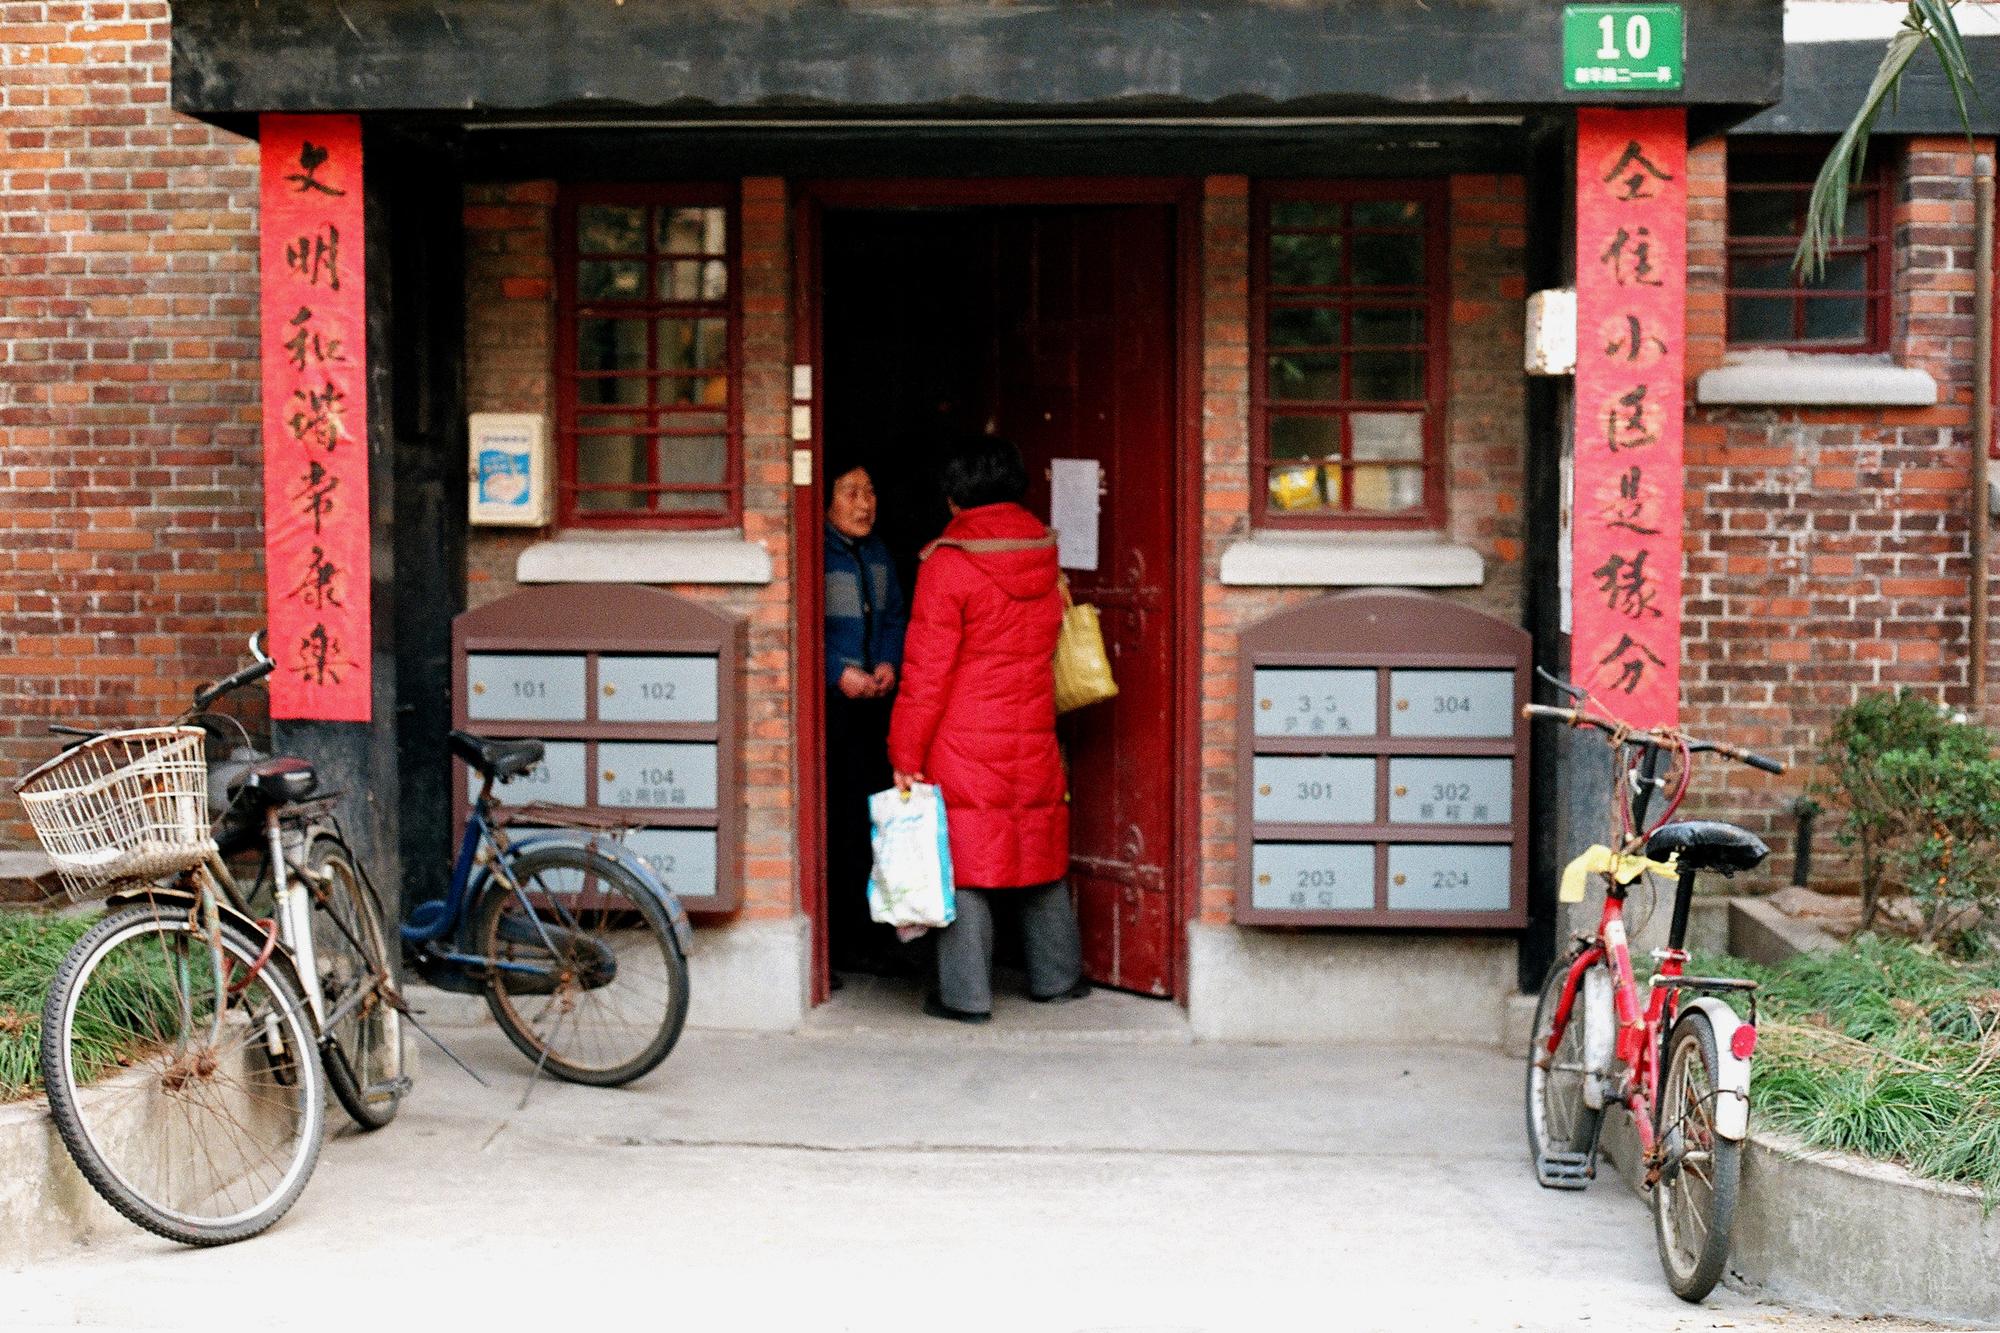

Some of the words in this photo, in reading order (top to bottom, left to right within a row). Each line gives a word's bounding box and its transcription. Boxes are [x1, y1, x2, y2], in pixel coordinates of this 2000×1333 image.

[1597, 14, 1651, 60] 10
[512, 680, 546, 699] 101
[640, 682, 676, 700] 102
[1433, 696, 1471, 714] 304
[639, 767, 674, 786] 104
[1298, 782, 1333, 800] 301
[1433, 783, 1471, 801] 302
[645, 854, 677, 873] 02
[1297, 869, 1336, 888] 203
